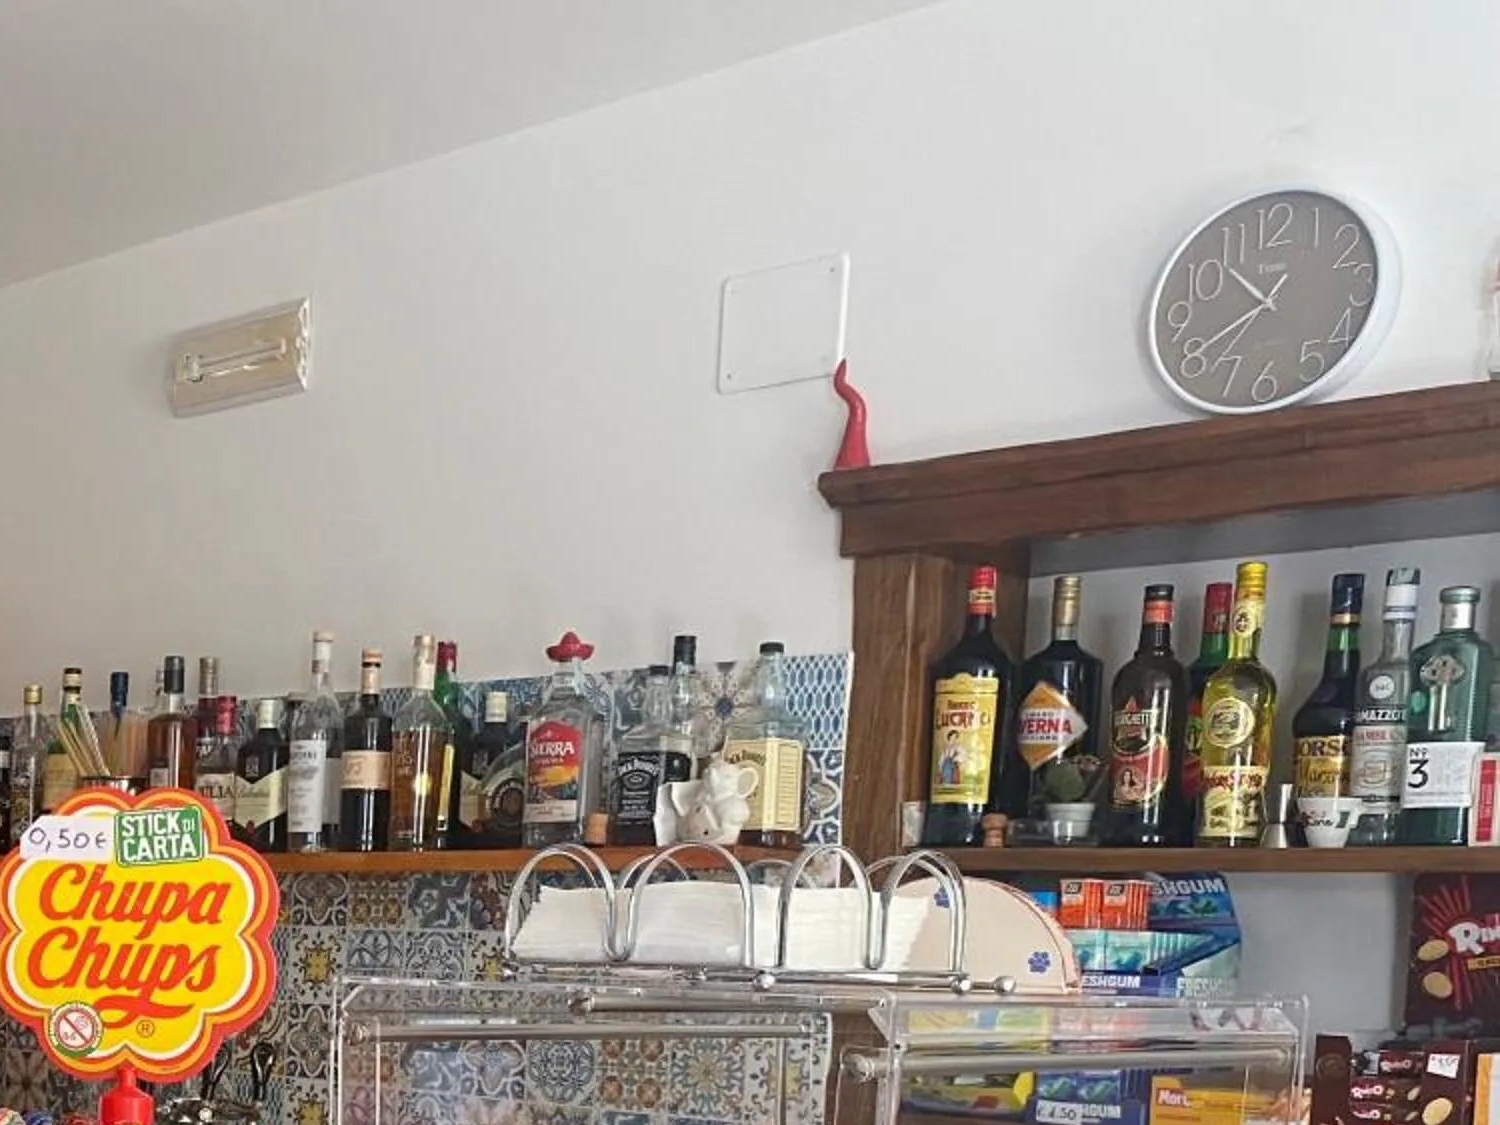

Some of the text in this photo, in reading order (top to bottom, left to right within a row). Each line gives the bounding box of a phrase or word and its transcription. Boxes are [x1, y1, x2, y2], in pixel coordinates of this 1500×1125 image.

[1221, 223, 1246, 267] 11
[1255, 203, 1293, 250] 12
[1332, 223, 1360, 269] 2
[1187, 259, 1223, 304] 10
[1349, 263, 1375, 307] 3
[1167, 301, 1193, 344] 9
[1327, 307, 1353, 350] 4
[1180, 337, 1206, 379] 8
[1216, 355, 1242, 398] 7
[1299, 339, 1325, 383] 5
[1251, 360, 1278, 402] 6
[1408, 759, 1429, 788] 3
[121, 811, 196, 836] STICK DI
[122, 836, 197, 861] CARTA
[39, 863, 232, 940] Chupa
[27, 926, 222, 1019] Chups
